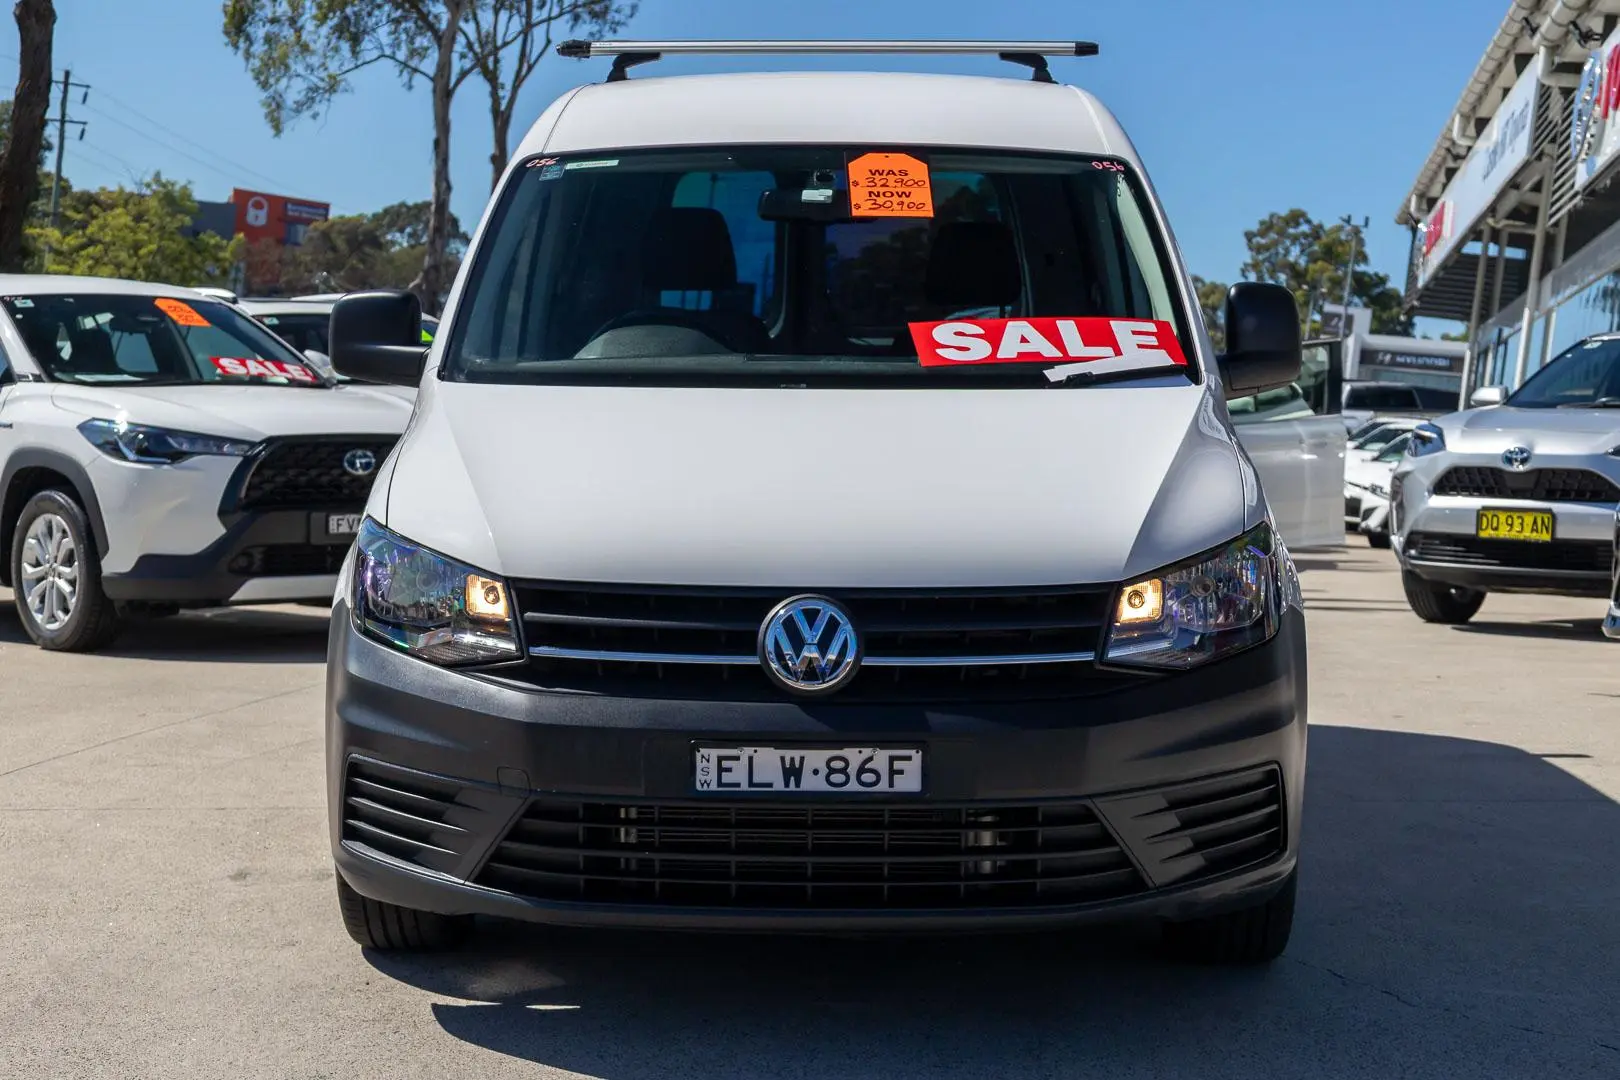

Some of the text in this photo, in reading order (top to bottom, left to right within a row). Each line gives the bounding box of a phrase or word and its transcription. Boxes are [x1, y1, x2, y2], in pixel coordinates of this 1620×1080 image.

[868, 169, 909, 177] WAS
[1092, 161, 1124, 171] 056
[932, 320, 1174, 366] SALE
[218, 357, 313, 381] SALE
[336, 517, 361, 532] FV
